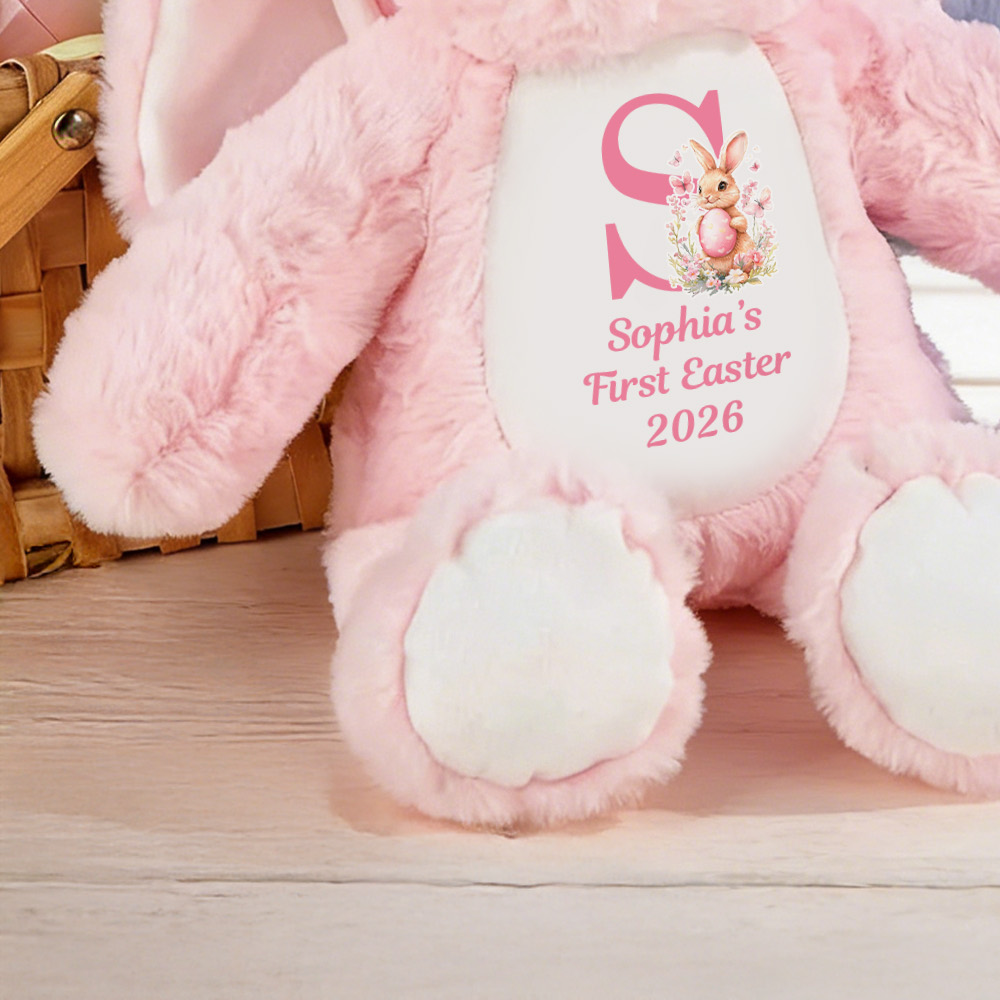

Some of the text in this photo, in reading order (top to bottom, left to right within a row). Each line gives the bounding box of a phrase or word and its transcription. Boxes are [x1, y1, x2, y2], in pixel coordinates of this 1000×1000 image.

[601, 89, 724, 300] S
[607, 299, 762, 361] Sophia’s
[583, 350, 791, 406] First Easter
[646, 400, 744, 448] 2026
